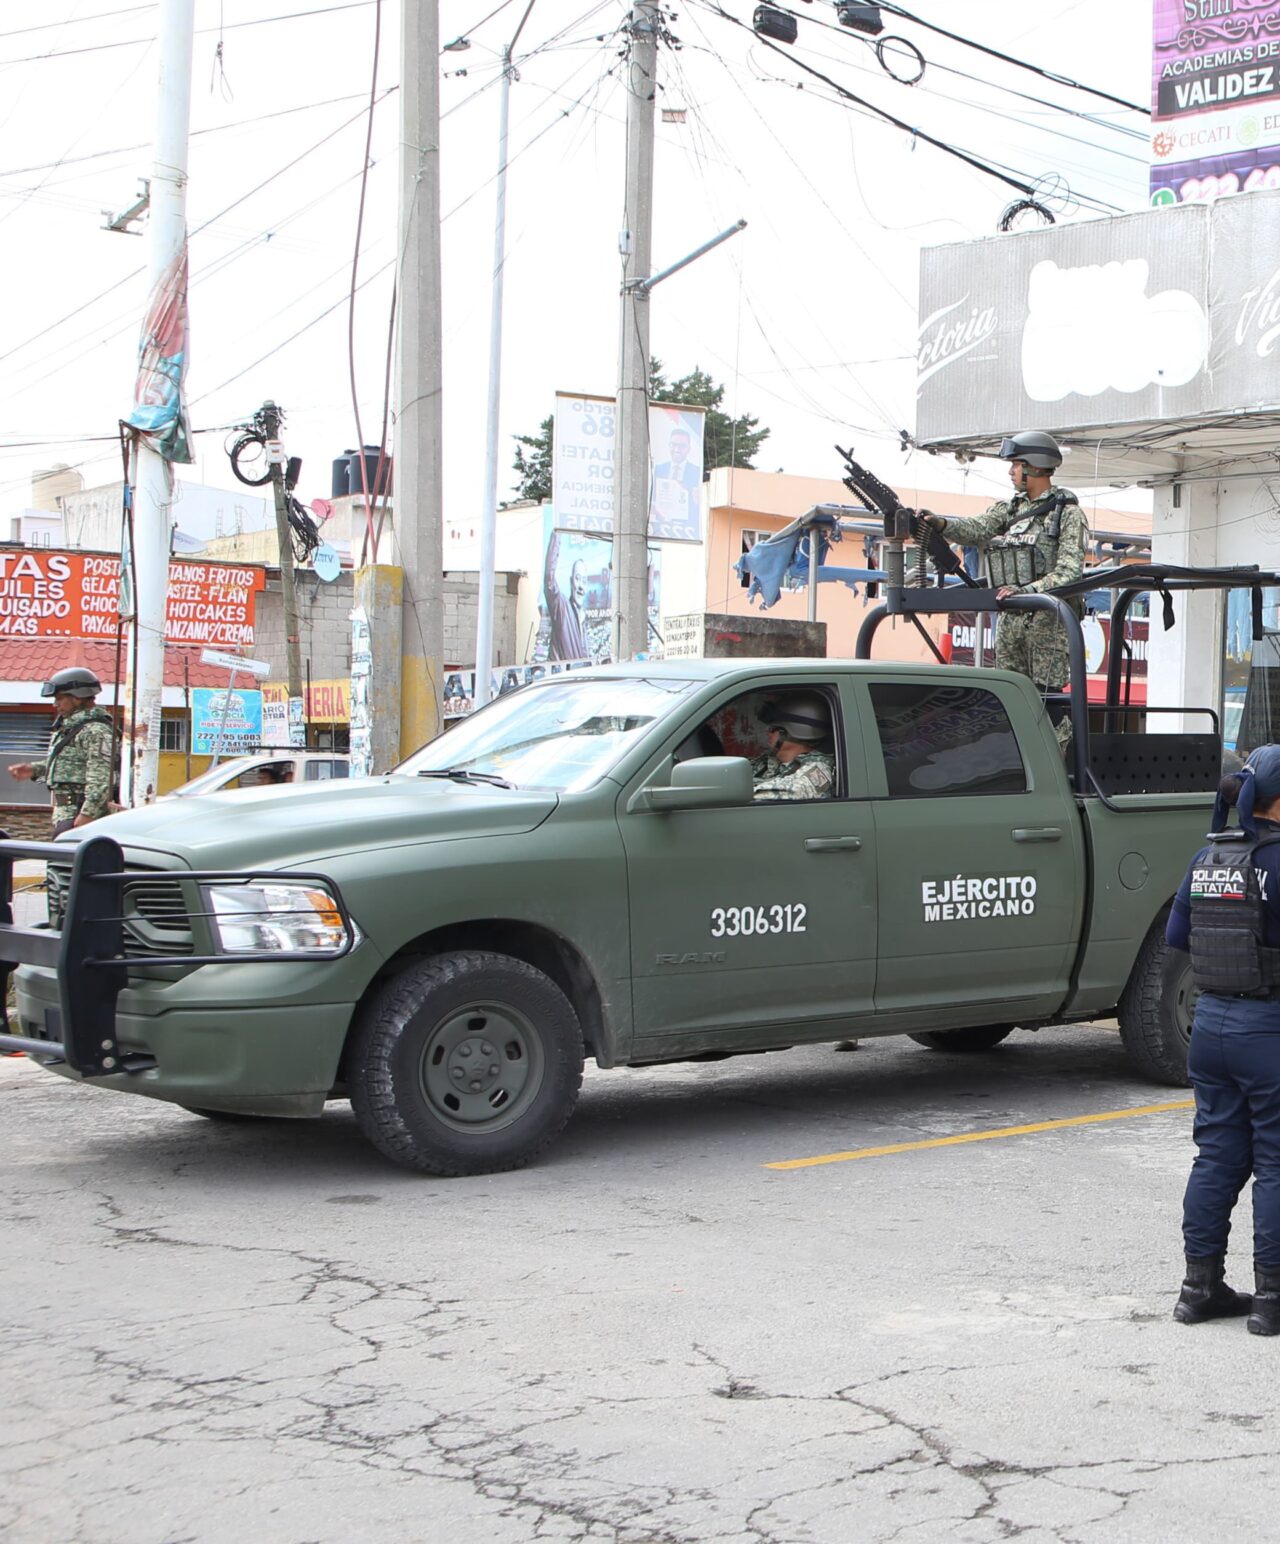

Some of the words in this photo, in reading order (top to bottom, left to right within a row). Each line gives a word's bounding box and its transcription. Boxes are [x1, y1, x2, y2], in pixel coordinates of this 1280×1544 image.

[1162, 47, 1253, 78] ACADEMIAS
[1258, 41, 1278, 59] DE
[1175, 66, 1273, 109] VALIDEZ
[1179, 125, 1231, 148] CECATI
[209, 568, 254, 586] FRITOS
[169, 602, 246, 621] HOTCAKES
[1192, 867, 1244, 882] POLICÍA
[922, 874, 1037, 903] EJÉRCITO
[1190, 882, 1243, 893] ESTATAL
[711, 904, 807, 937] 3306312
[924, 899, 1034, 922] MEXICANO
